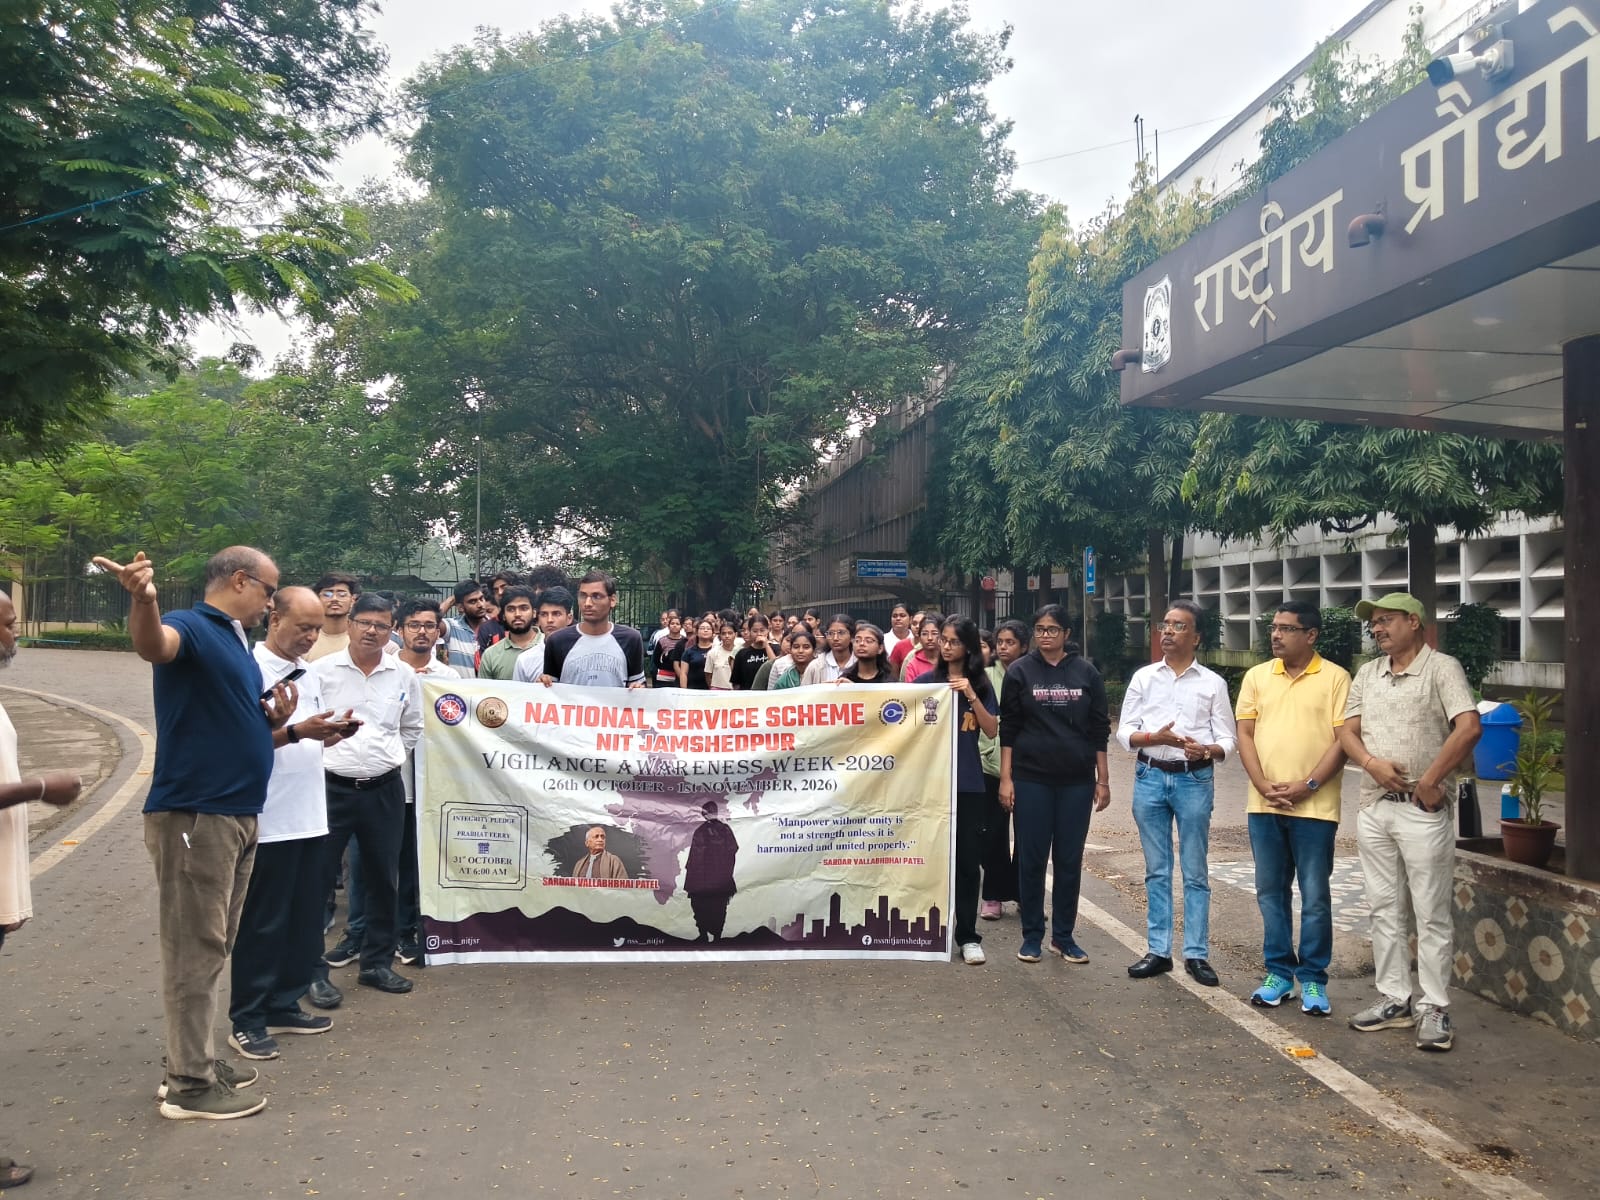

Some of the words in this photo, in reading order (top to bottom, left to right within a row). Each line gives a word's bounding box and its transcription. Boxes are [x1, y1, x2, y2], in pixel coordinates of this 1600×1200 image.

[1194, 188, 1343, 332] राष्ट्रीय
[524, 702, 650, 729] NATIONAL
[657, 707, 759, 730] SERVICE
[765, 703, 865, 727] SCHEME
[596, 733, 634, 752] NIT
[638, 732, 795, 753] JAMSHEDPUR
[482, 751, 607, 773] VIGILANCE
[616, 756, 763, 776] AWARENESS
[543, 778, 578, 792] (26th
[583, 778, 665, 793] OCTOBER
[677, 781, 697, 793] 1st
[701, 779, 797, 793] NOVEMBER,
[801, 778, 838, 792] 2026)
[453, 815, 489, 823] INTEGRITY
[772, 816, 830, 828] "Manpower
[832, 816, 867, 826] without
[869, 816, 893, 827] unity
[896, 815, 904, 824] is
[457, 830, 488, 838] PRABHAT
[780, 830, 796, 840] not
[798, 832, 804, 840] a
[806, 829, 845, 842] strength
[847, 829, 876, 839] unless
[877, 828, 885, 837] it
[887, 828, 895, 837] is
[757, 844, 814, 853] harmonized
[815, 843, 833, 852] and
[835, 842, 865, 851] united
[467, 856, 513, 865] OCTOBER
[823, 858, 852, 866] SARDAR
[903, 857, 926, 865] PATEL
[459, 867, 471, 875] AT
[473, 867, 490, 876] 6:00
[492, 868, 507, 876] AM
[542, 876, 576, 887] SARDAR
[578, 878, 634, 889] VALLABHBHAI
[636, 879, 659, 889] PATEL
